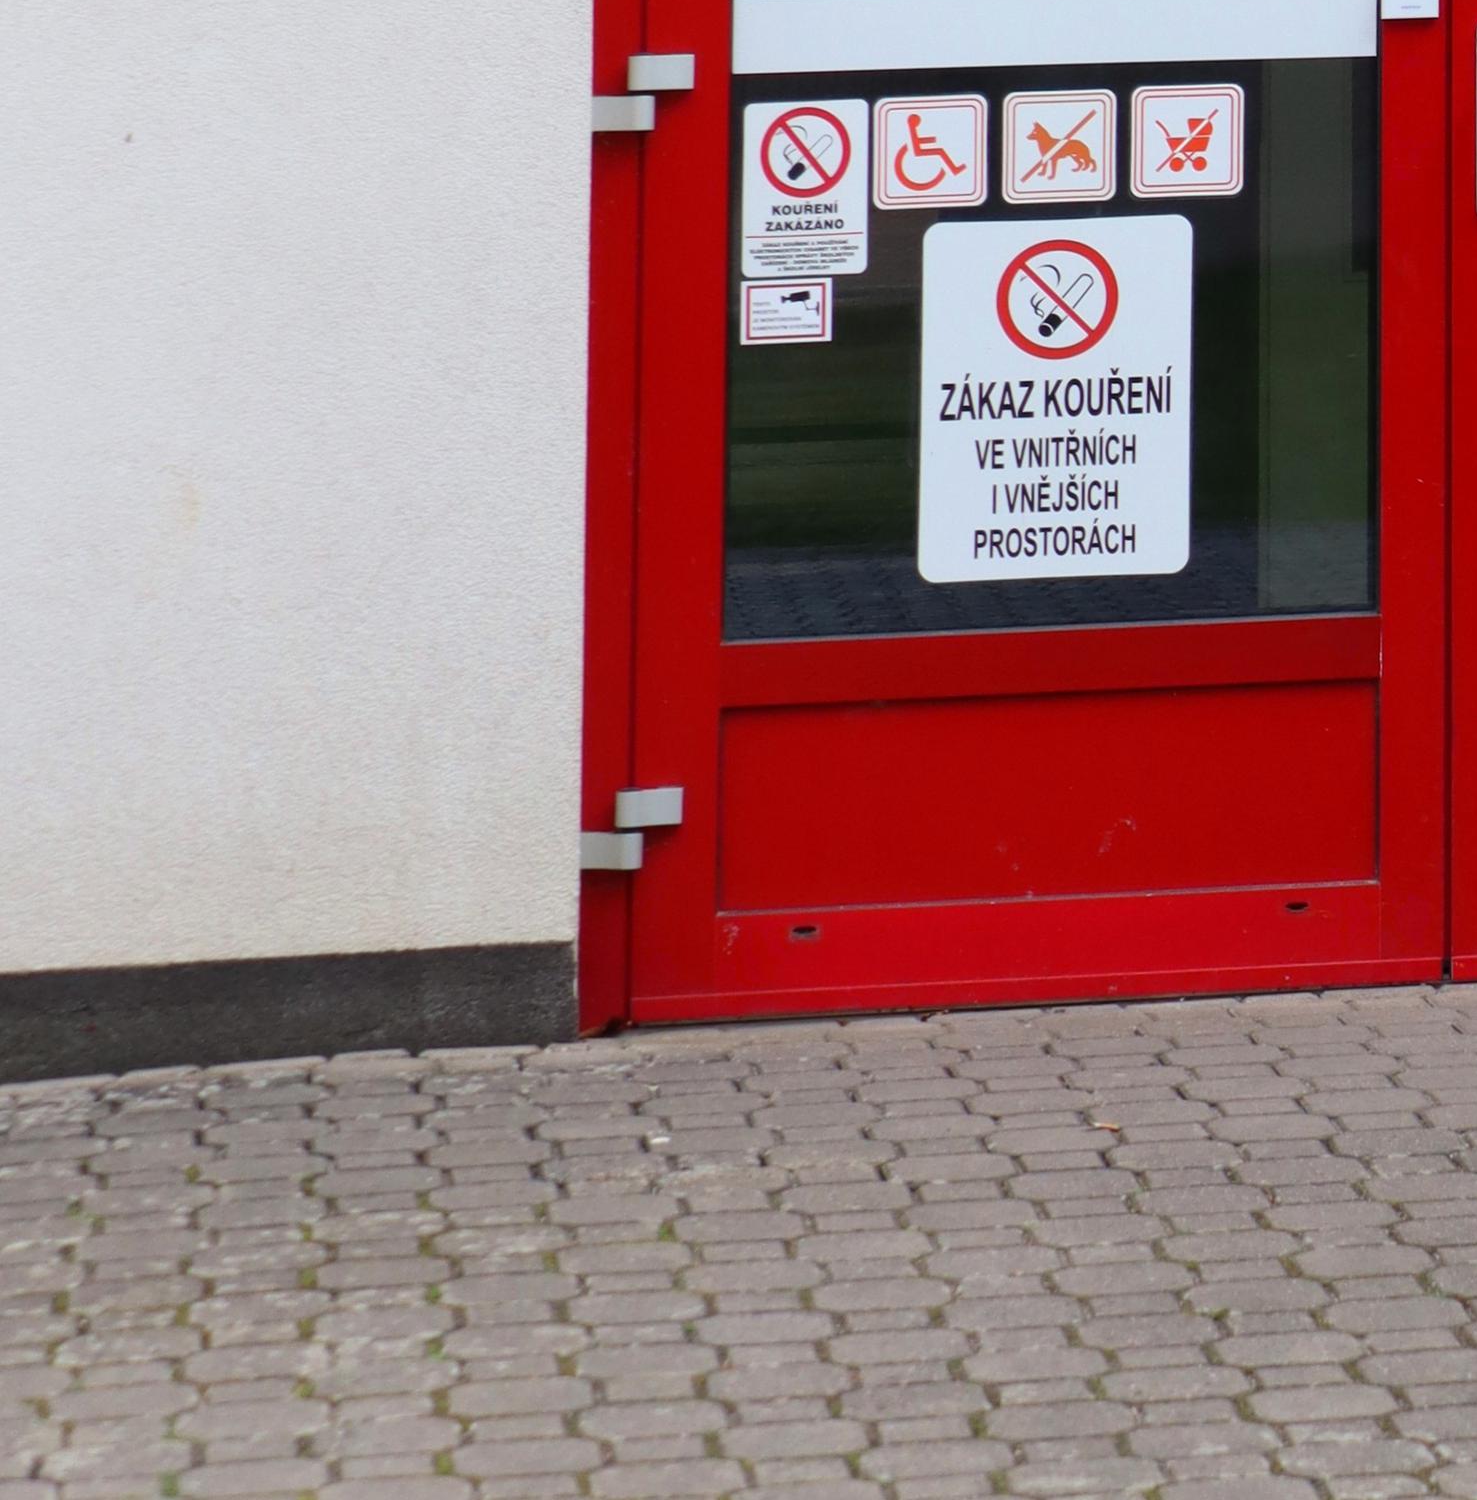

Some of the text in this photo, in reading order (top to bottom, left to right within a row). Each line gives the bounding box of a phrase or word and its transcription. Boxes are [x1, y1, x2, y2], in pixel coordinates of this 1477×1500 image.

[772, 200, 838, 216] KOUŘENÍ
[939, 365, 1172, 421] ZÁKAZ KOUŘENÍ
[975, 428, 1137, 470] VE VNITŘNÍCH
[992, 473, 1119, 514] I VNĚJŠÍCH
[974, 518, 1136, 559] PROSTORÁCH
